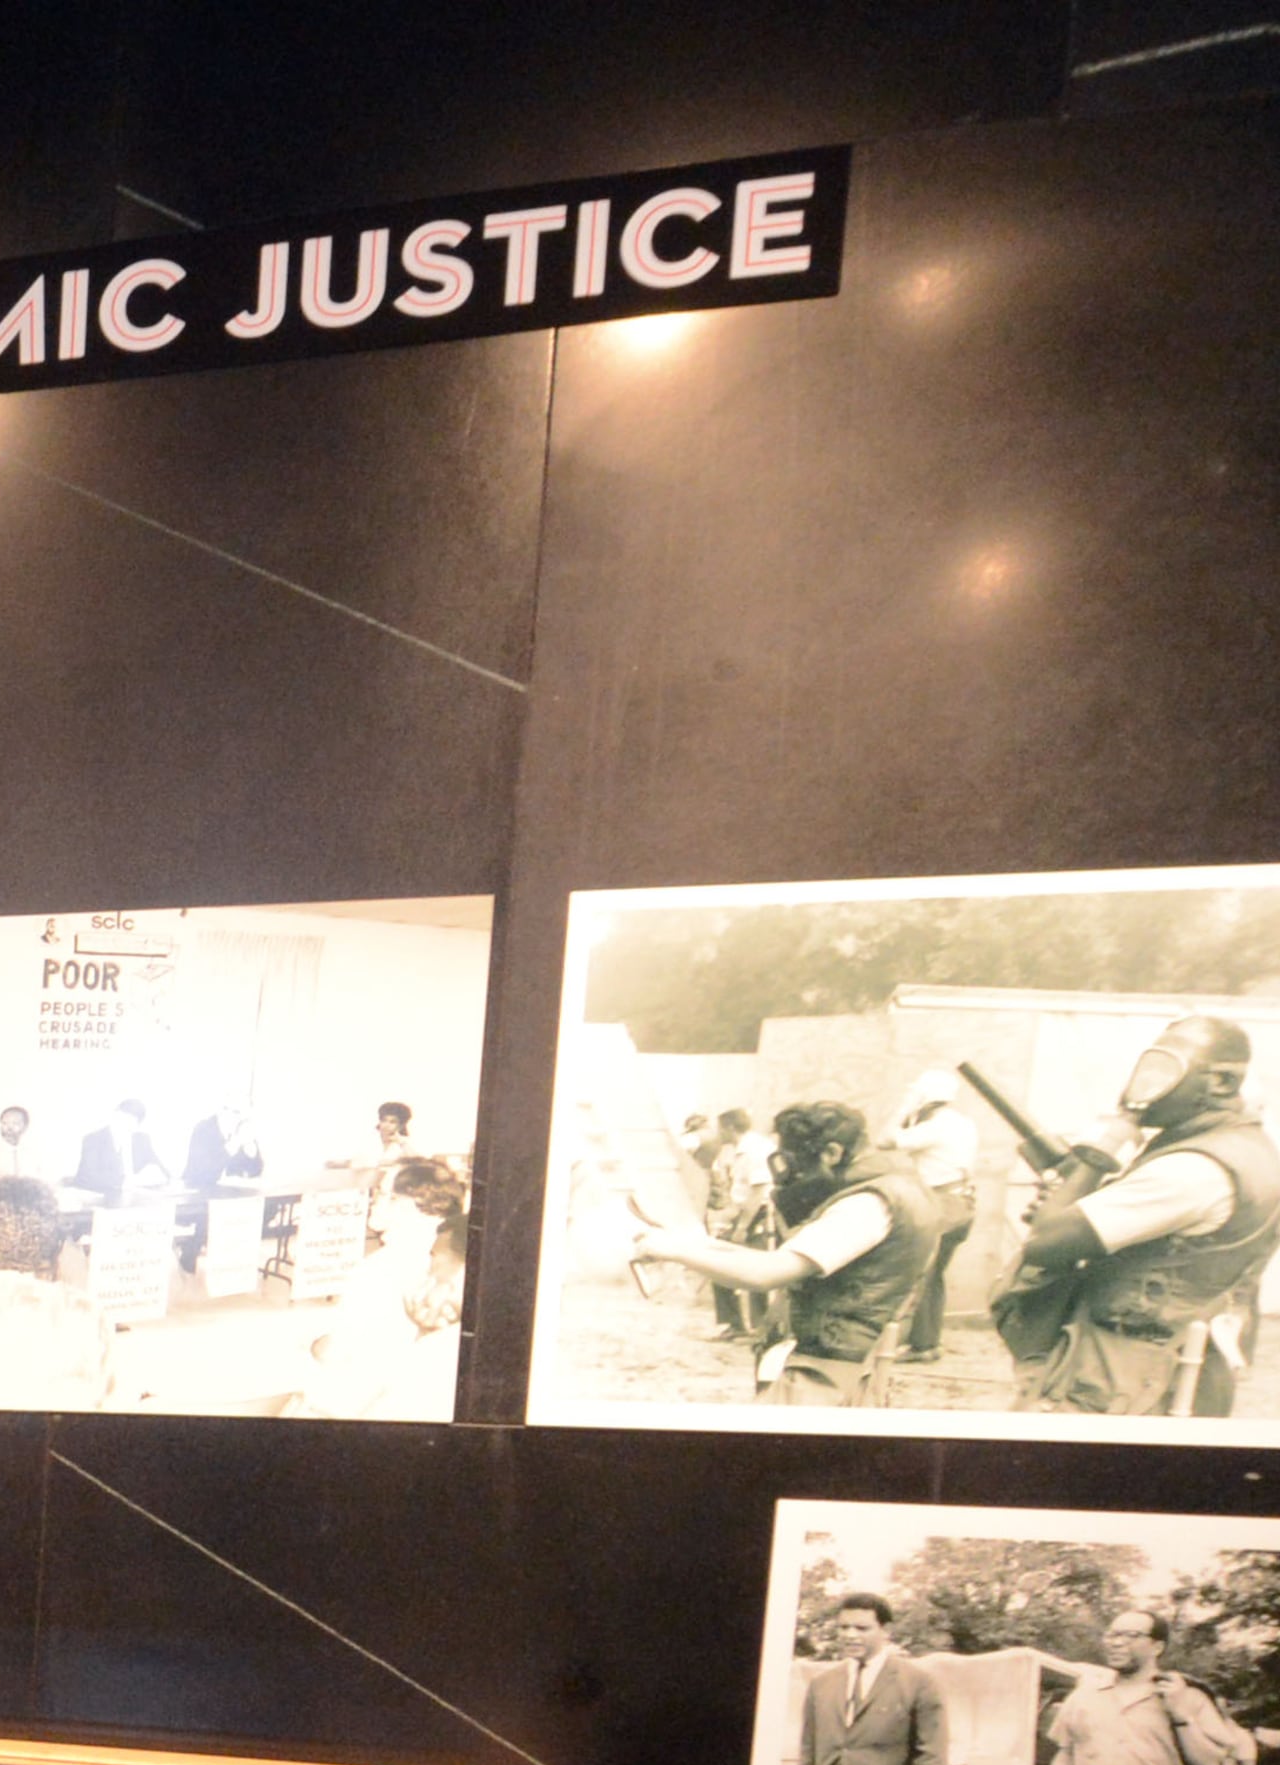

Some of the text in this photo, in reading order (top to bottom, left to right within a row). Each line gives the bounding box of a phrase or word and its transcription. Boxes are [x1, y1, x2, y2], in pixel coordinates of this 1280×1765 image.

[225, 170, 816, 340] JUSTICE
[42, 958, 121, 992] POOR
[40, 1001, 125, 1017] PEOPLES
[38, 1020, 118, 1035] CRUSADE
[39, 1038, 111, 1051] HEARING
